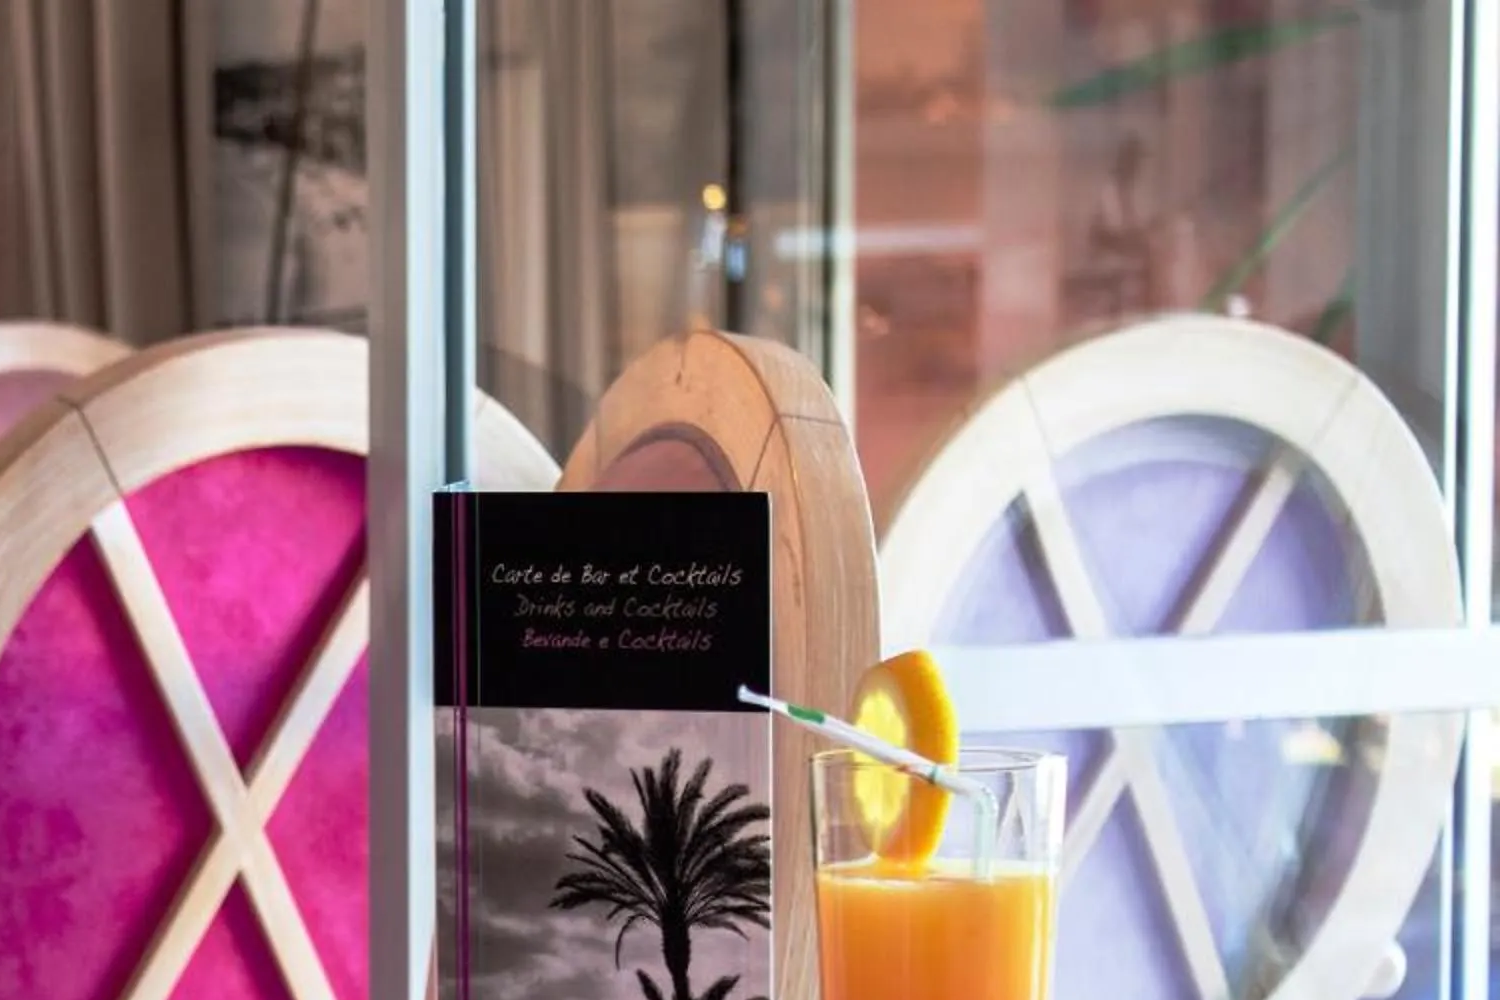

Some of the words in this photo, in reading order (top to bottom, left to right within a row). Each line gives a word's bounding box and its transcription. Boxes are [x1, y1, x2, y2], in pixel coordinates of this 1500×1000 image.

[491, 563, 543, 585] Carte
[550, 564, 572, 585] de
[580, 563, 611, 585] Bar
[618, 564, 640, 586] et
[647, 562, 743, 588] Cocktails
[514, 594, 576, 618] Drinks
[583, 597, 617, 617] and
[623, 594, 719, 620] Cocktails
[522, 629, 591, 649] Bevande
[598, 636, 609, 649] e
[618, 627, 713, 652] Cocktails
